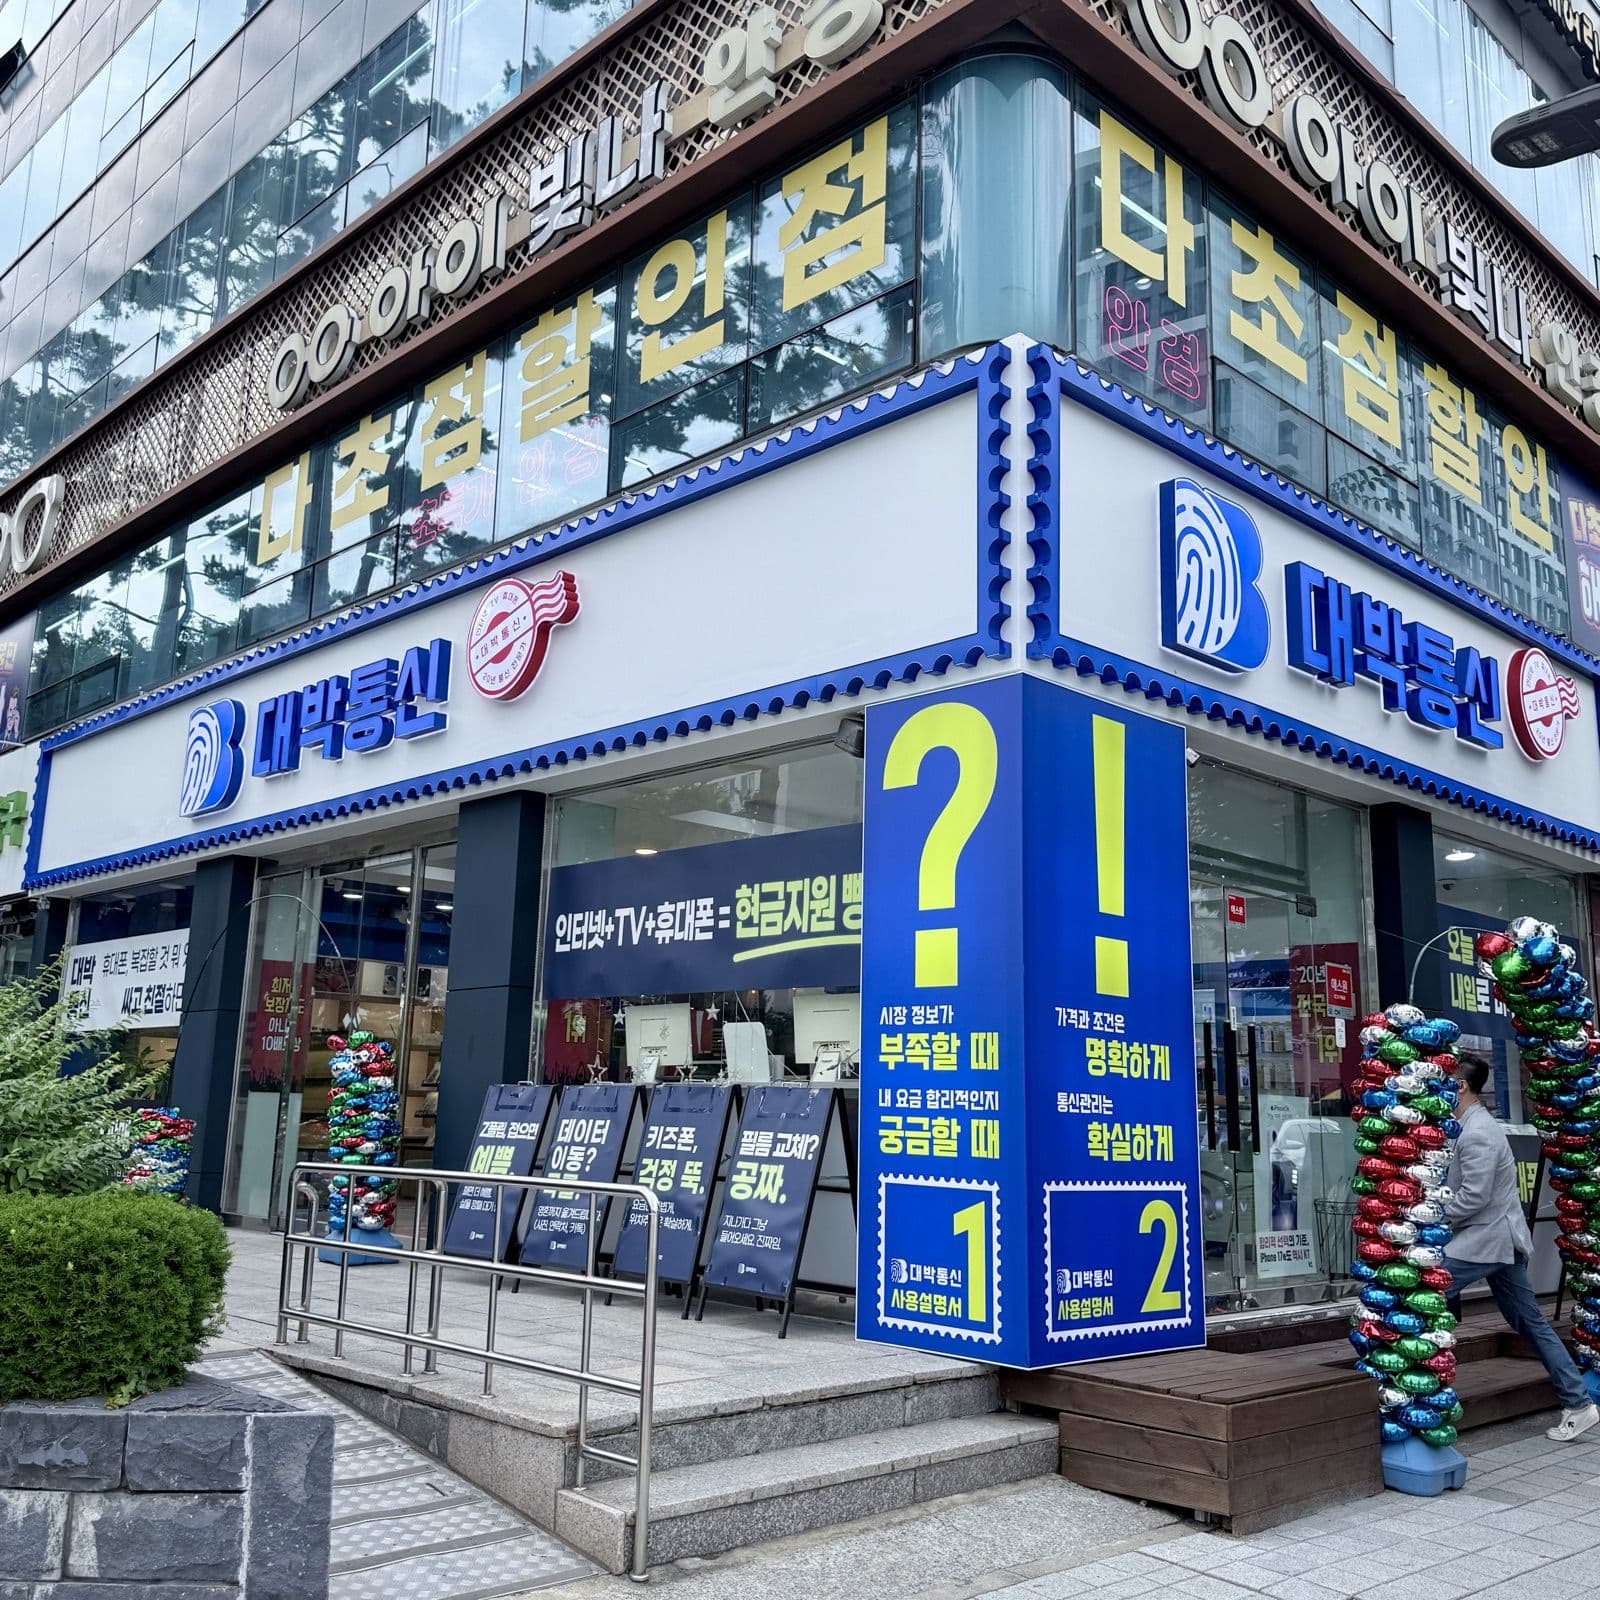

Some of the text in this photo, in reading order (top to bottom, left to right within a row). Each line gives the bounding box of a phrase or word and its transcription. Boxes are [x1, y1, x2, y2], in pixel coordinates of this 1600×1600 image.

[1105, 285, 1201, 401] 안경
[1284, 560, 1504, 752] 대박통신
[252, 637, 453, 780] 대박통신
[735, 874, 836, 939] 현금지원
[71, 955, 97, 985] 대박
[131, 947, 159, 973] 복잡할
[160, 945, 170, 970] 것
[171, 943, 182, 969] 뭐
[121, 986, 143, 1016] 싸고
[880, 1005, 954, 1025] 시장 정보가
[1055, 1007, 1126, 1033] 가격과 조건은
[879, 1032, 999, 1071] 부족할 때
[1085, 1037, 1171, 1081] 명확하게
[879, 1088, 999, 1111] 내 요금 합리적인지
[1057, 1092, 1114, 1115] 통신관리는
[507, 1122, 540, 1140] 접으면
[557, 1118, 611, 1144] 데이터
[646, 1126, 698, 1153] 키즈폰,
[739, 1130, 820, 1161] 필름 교체?
[879, 1115, 1000, 1159] 궁금할 때
[1087, 1121, 1174, 1162] 확실하게
[551, 1146, 598, 1173] 이동?
[638, 1158, 705, 1194] 걱정 뚝.
[730, 1160, 787, 1204] 공짜.
[722, 1214, 768, 1232] 지나가다 그냥
[953, 1200, 986, 1323] 1
[1138, 1200, 1182, 1313] 2
[910, 1263, 962, 1288] 대박통신
[1072, 1269, 1114, 1289] 대박통신
[890, 1289, 963, 1319] 사용설명서
[1057, 1296, 1114, 1321] 사용설명서
